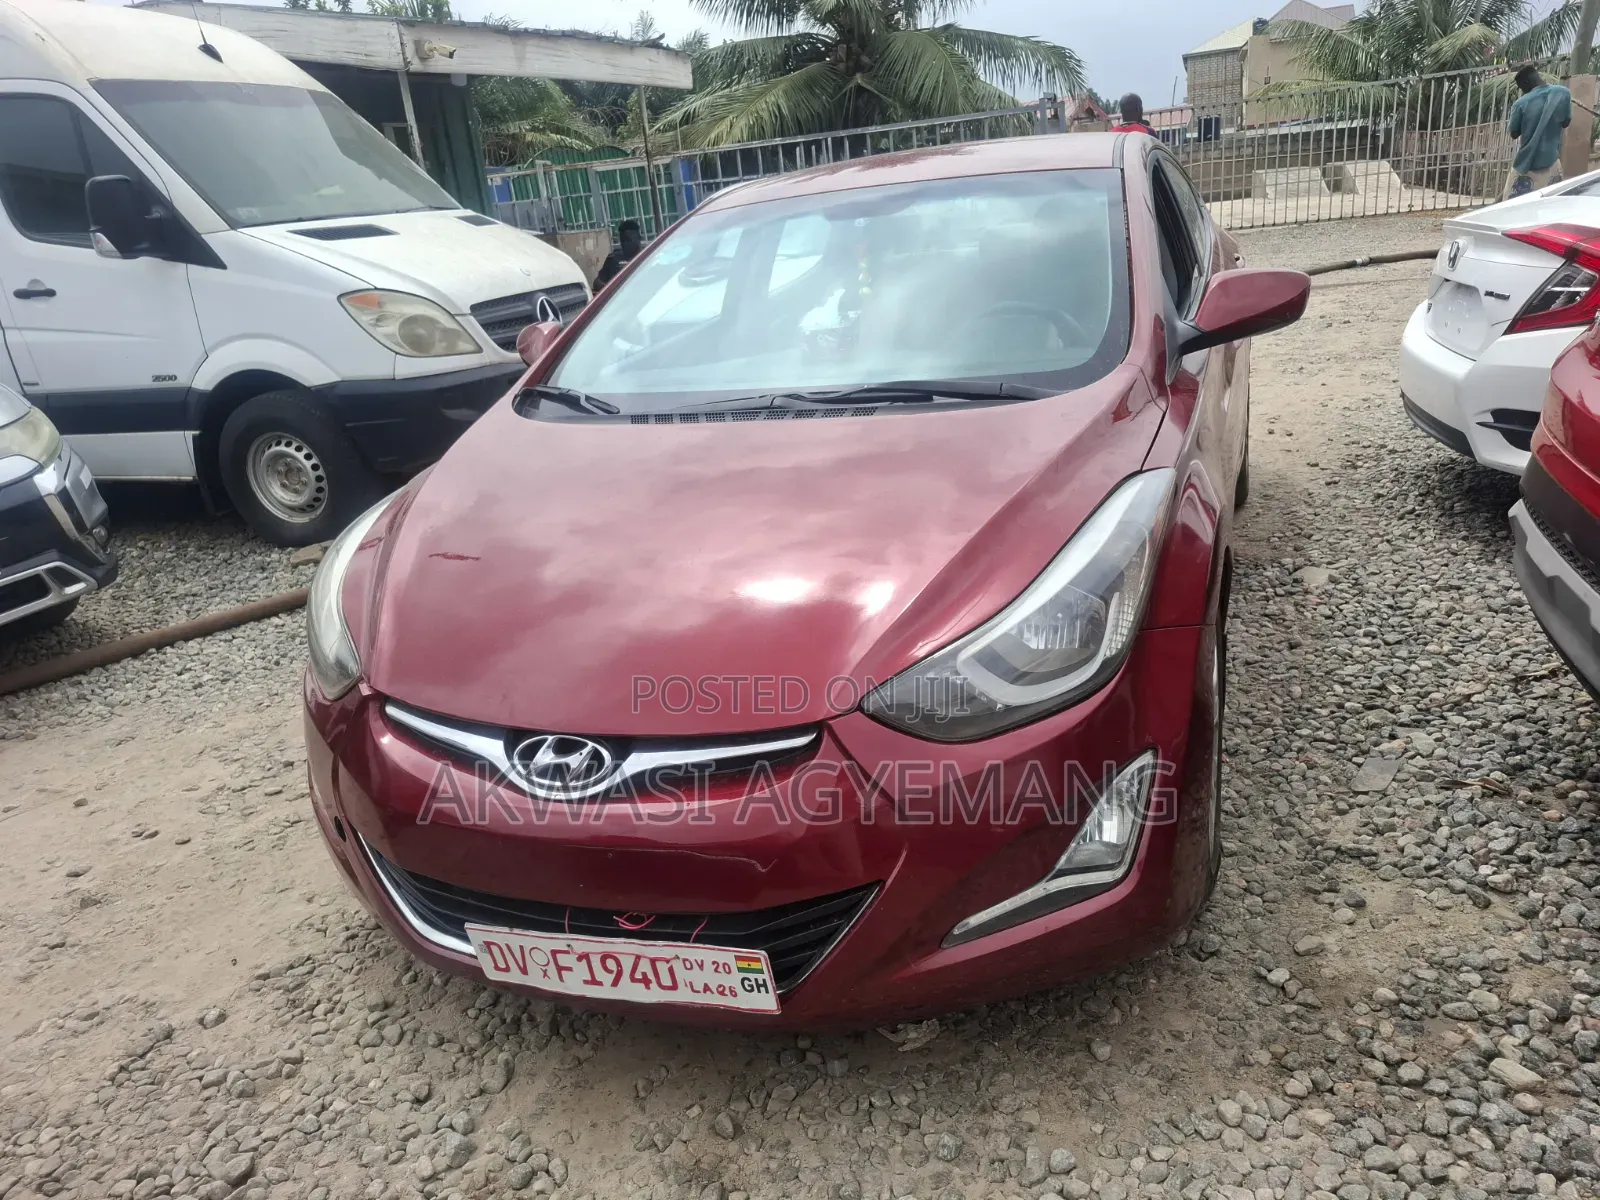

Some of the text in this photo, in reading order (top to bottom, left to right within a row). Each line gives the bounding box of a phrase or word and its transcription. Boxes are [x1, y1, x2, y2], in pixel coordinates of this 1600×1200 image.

[151, 374, 178, 382] 2500
[482, 940, 529, 976] DV
[682, 957, 732, 975] DV 20
[740, 976, 770, 995] GH
